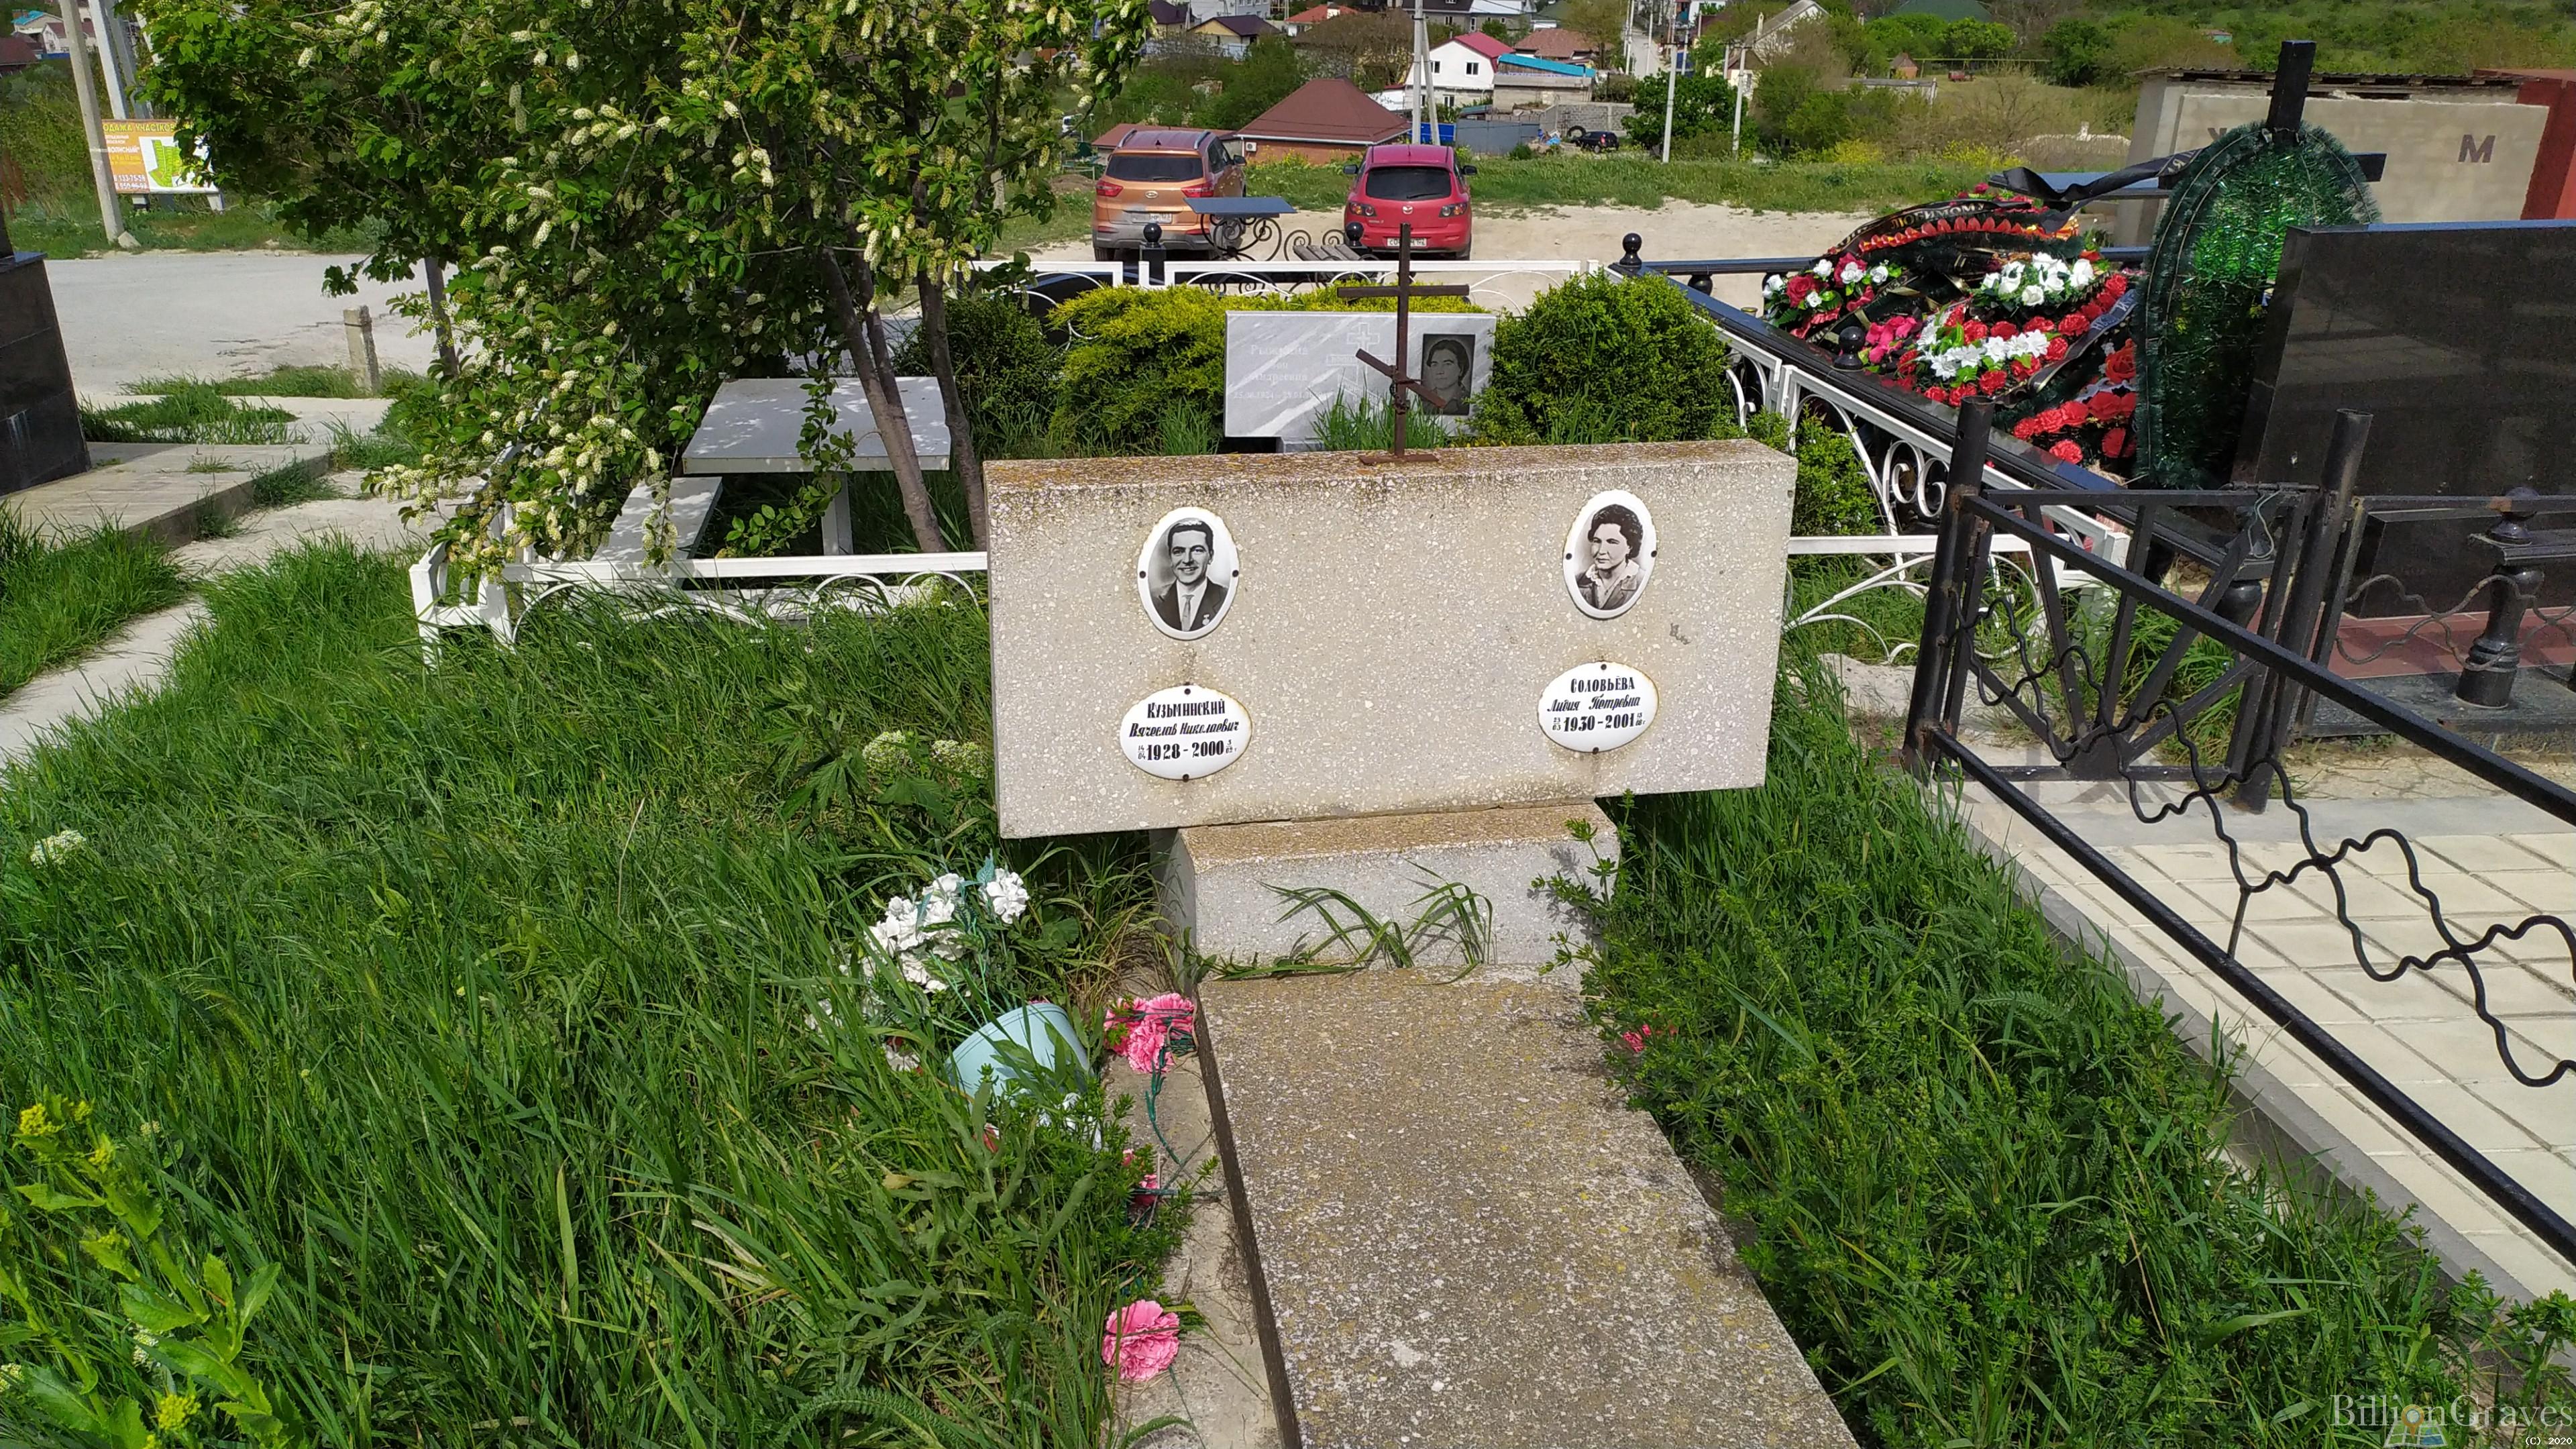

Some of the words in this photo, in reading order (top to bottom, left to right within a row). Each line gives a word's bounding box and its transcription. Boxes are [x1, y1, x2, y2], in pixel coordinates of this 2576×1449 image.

[103, 123, 132, 132] ОДАЖА
[135, 123, 175, 132] УЧАСТКОВ
[1891, 203, 1985, 229] ЛЮБИМОМУ
[1147, 698, 1226, 718] КУЗЬМИНСКИЙ
[1547, 698, 1580, 712] Лидия
[1589, 694, 1640, 711] Петровна
[1129, 722, 1177, 737] Вячеслав
[1179, 718, 1239, 735] Николаевич
